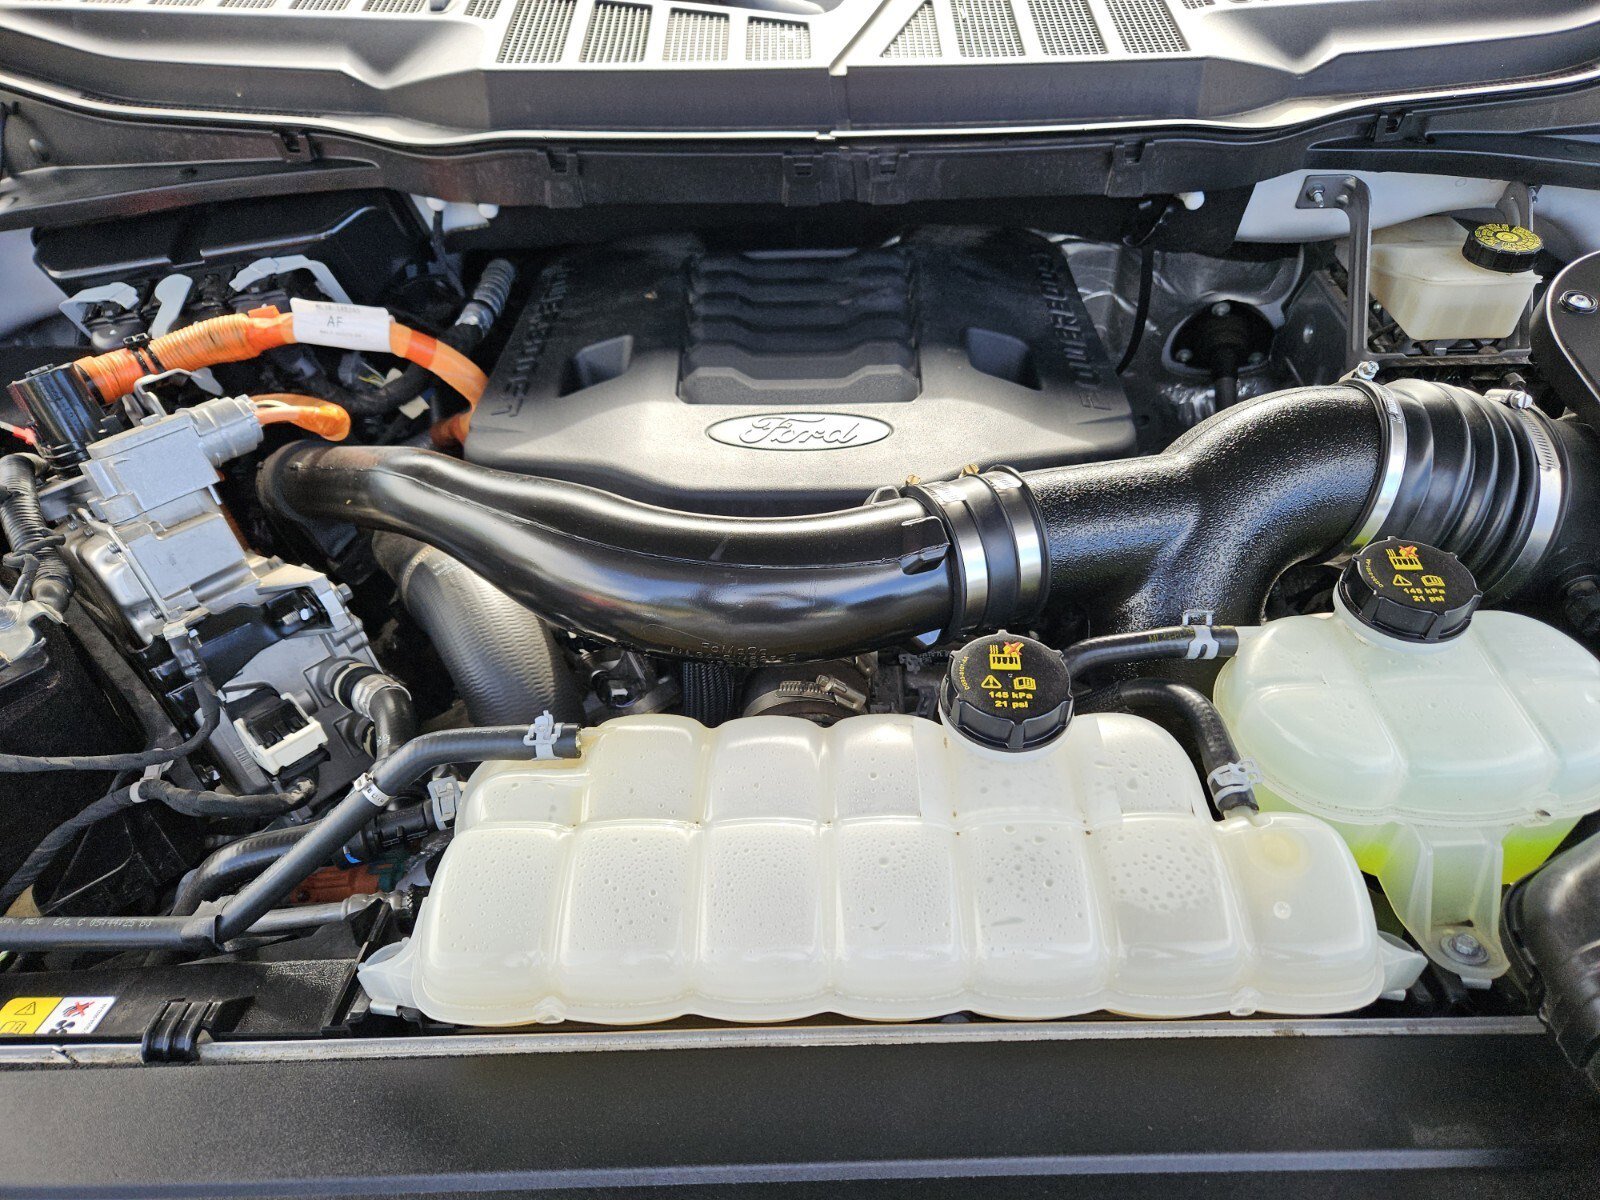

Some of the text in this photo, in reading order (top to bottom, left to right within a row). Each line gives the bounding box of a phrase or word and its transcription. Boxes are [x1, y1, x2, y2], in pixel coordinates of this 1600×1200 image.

[327, 316, 343, 327] AF
[739, 417, 859, 443] Ford
[1428, 595, 1445, 603] psi
[988, 691, 1034, 699] 145 kPa
[995, 700, 1029, 709] 21 psi
